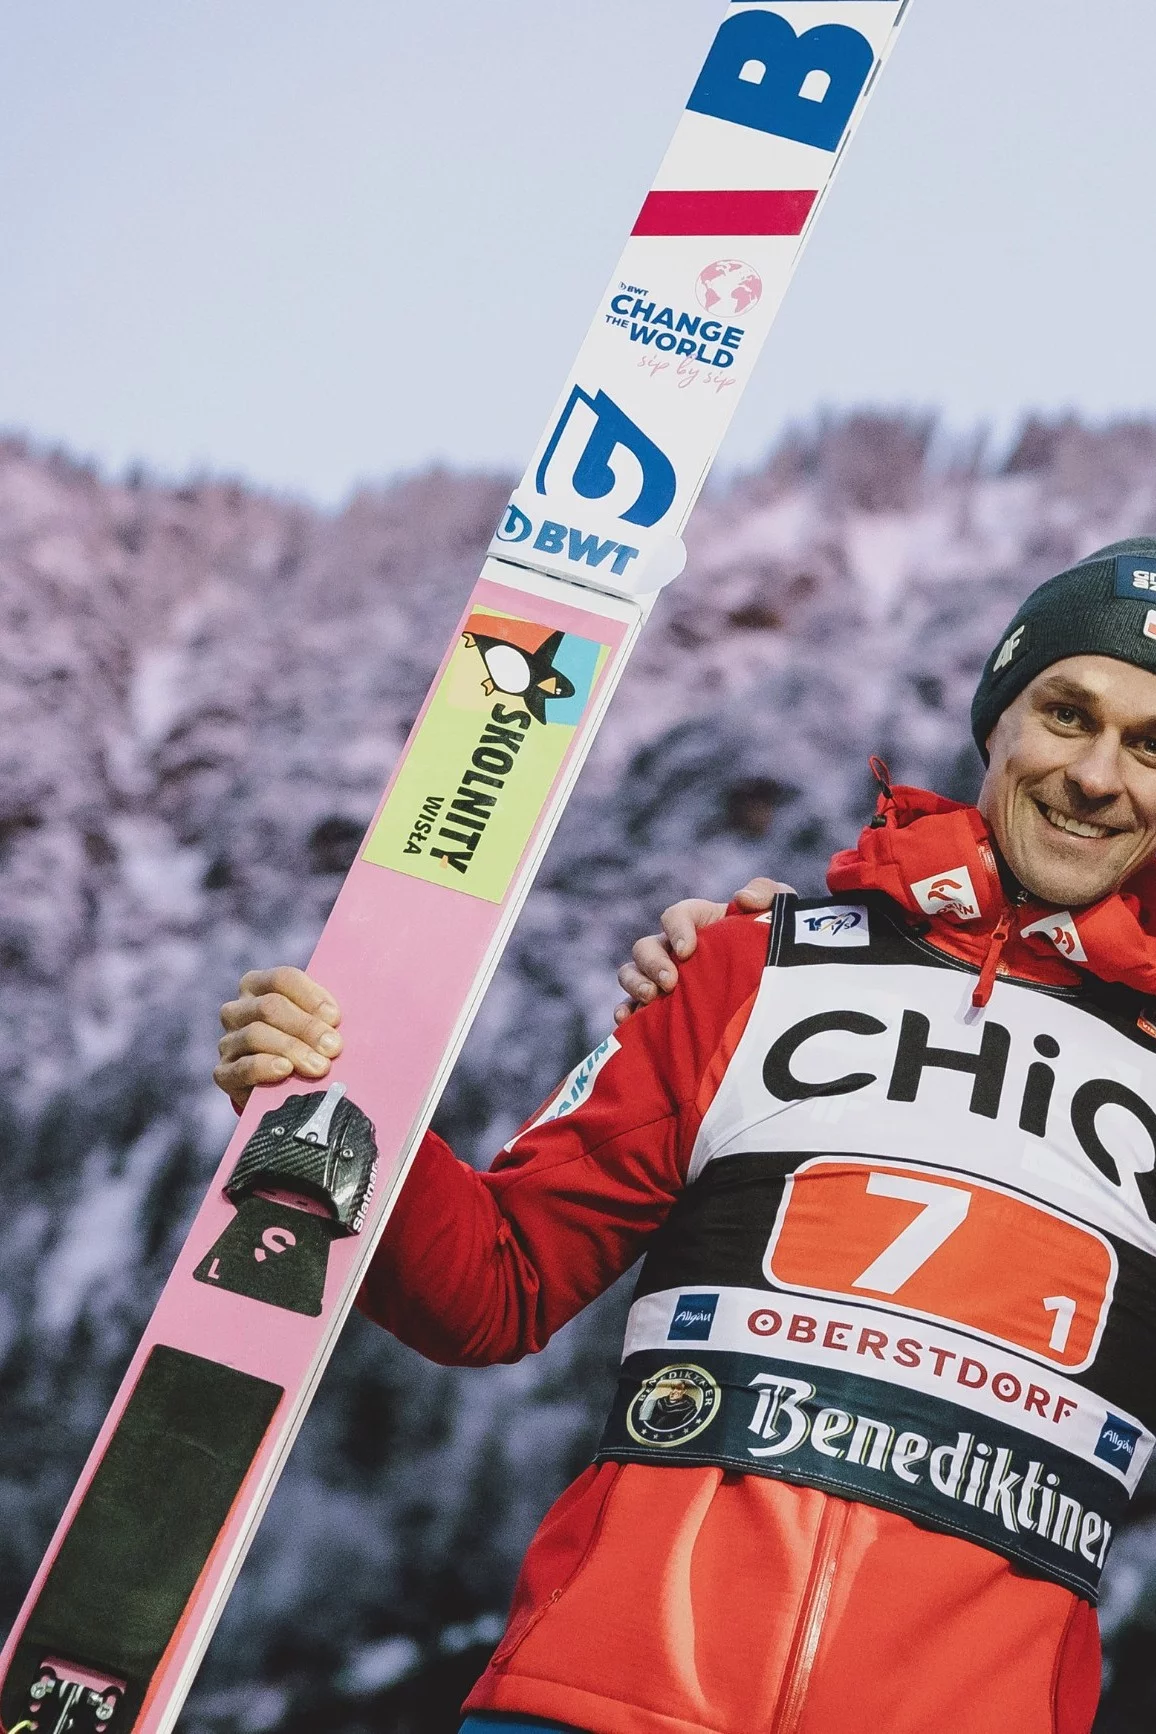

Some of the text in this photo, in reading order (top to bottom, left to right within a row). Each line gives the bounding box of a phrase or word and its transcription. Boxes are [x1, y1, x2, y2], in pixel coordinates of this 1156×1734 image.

[685, 0, 876, 153] B
[610, 294, 745, 350] CHANGE
[626, 285, 649, 297] BWT
[605, 314, 734, 368] THE WORLD
[637, 352, 737, 394] sip by sip
[533, 519, 640, 577] BWT
[430, 703, 532, 875] SKOLNITY
[546, 1040, 609, 1120] AIKIN
[851, 1172, 973, 1295] 7
[1043, 1295, 1077, 1353] 1
[747, 1308, 1078, 1425] OBERSTDORF
[747, 1373, 1112, 1570] Benediktiner
